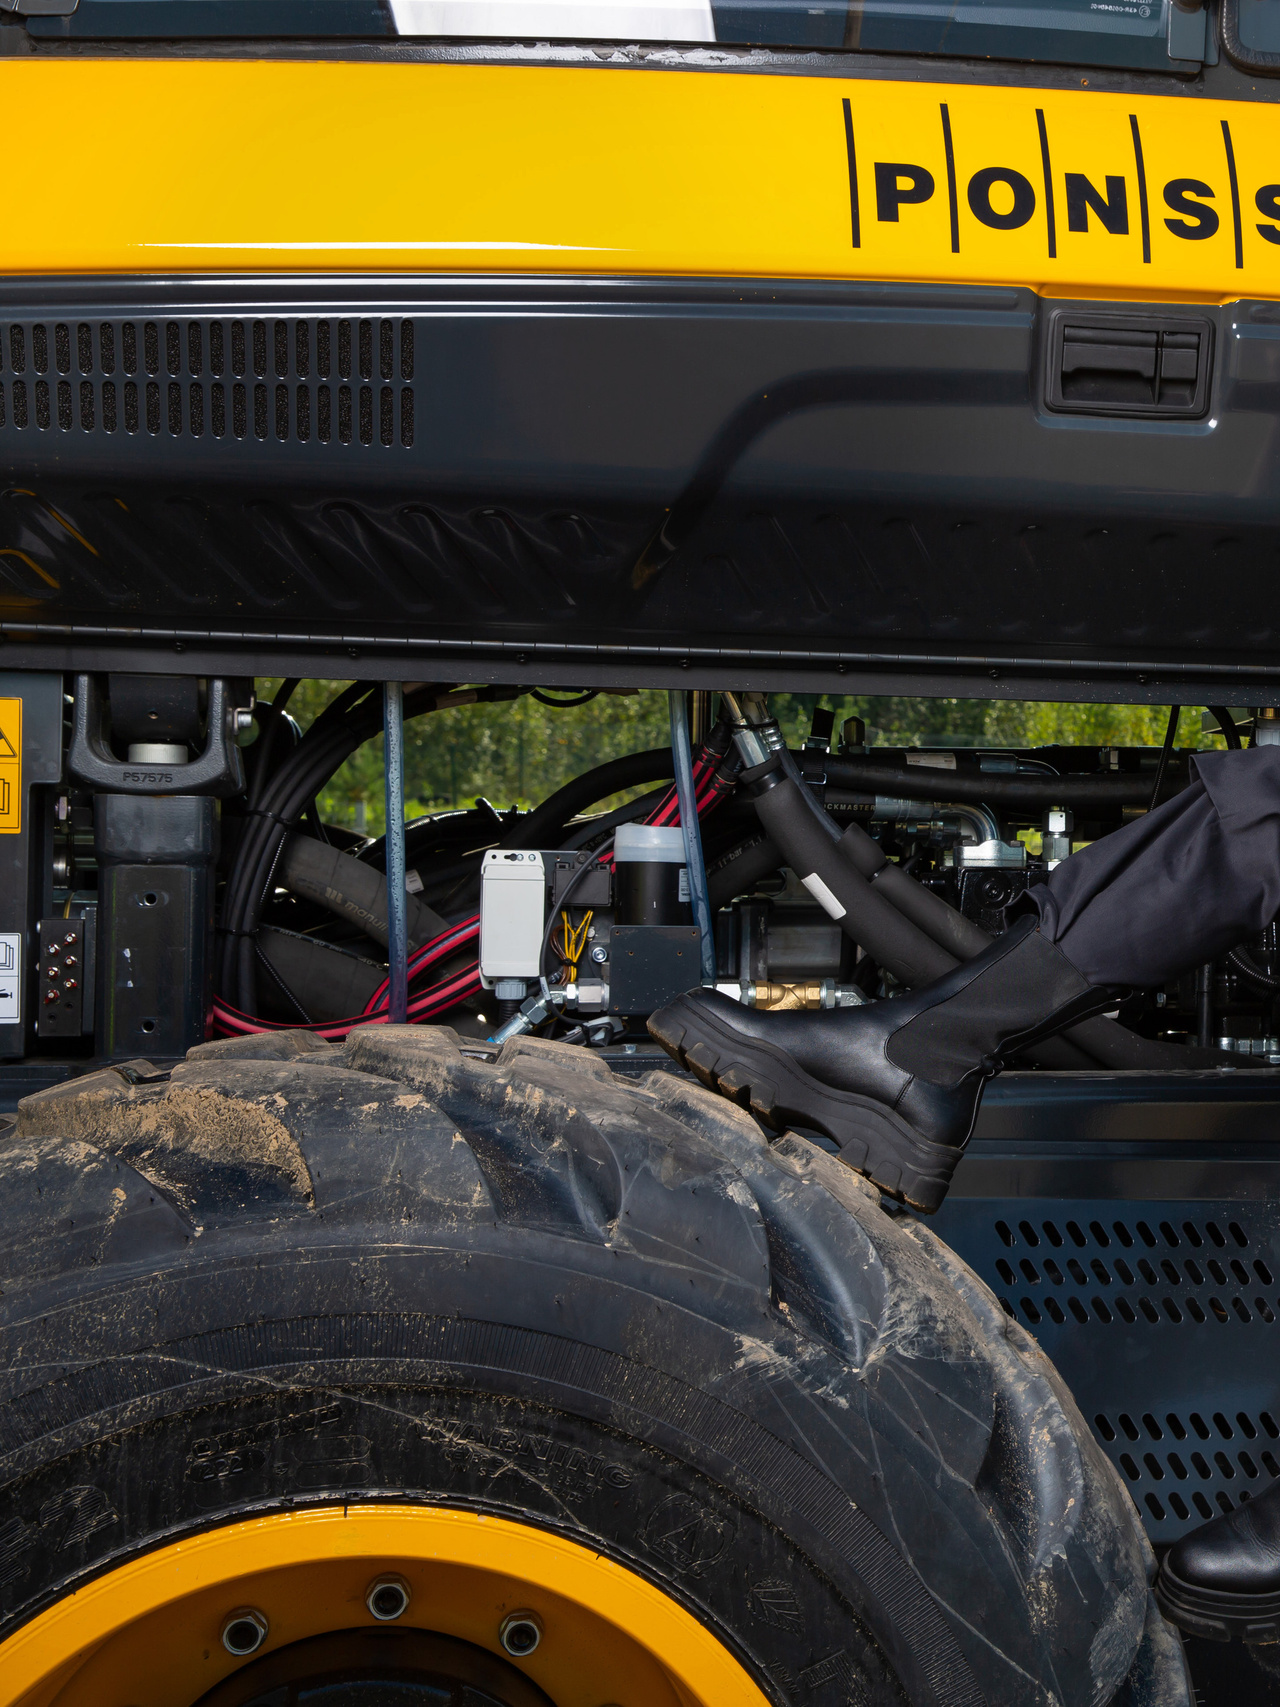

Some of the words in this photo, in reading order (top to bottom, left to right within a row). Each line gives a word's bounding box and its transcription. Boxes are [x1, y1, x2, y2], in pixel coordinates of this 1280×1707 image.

[122, 771, 174, 783] P57575
[824, 803, 876, 811] CKMASTER
[729, 847, 743, 861] bar
[344, 901, 389, 932] manuli
[413, 1415, 634, 1489] WARNING
